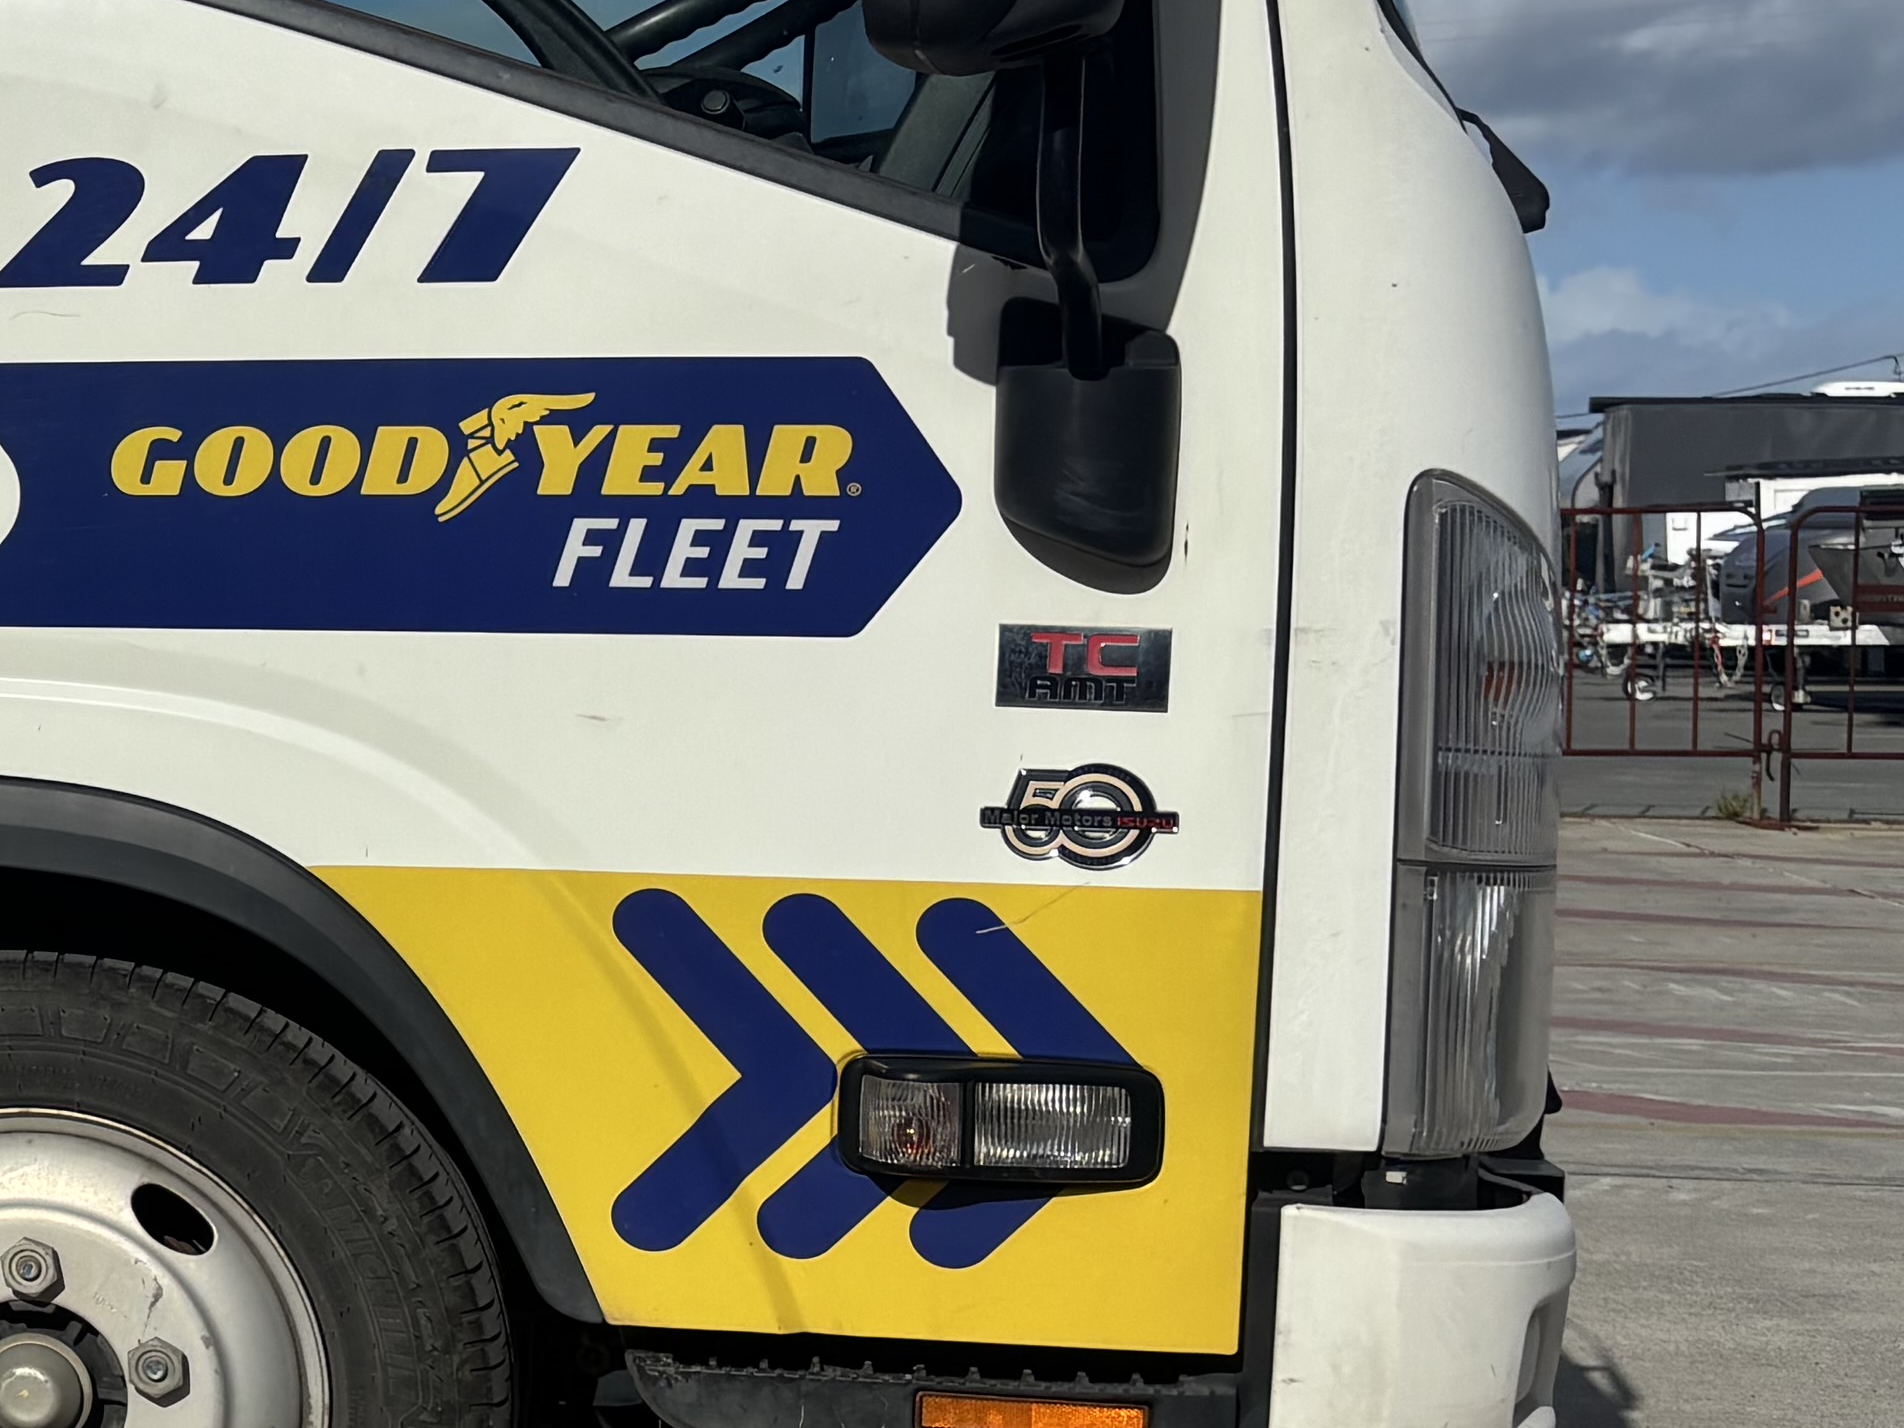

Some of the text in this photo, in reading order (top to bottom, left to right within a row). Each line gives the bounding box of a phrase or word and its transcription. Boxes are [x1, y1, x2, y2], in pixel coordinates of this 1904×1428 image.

[112, 425, 853, 497] GOODYEAR
[552, 518, 841, 590] FLEET
[1031, 632, 1140, 676] TC
[1026, 677, 1137, 702] AMT
[1044, 811, 1112, 827] Motors
[1117, 816, 1174, 829] ISUZU
